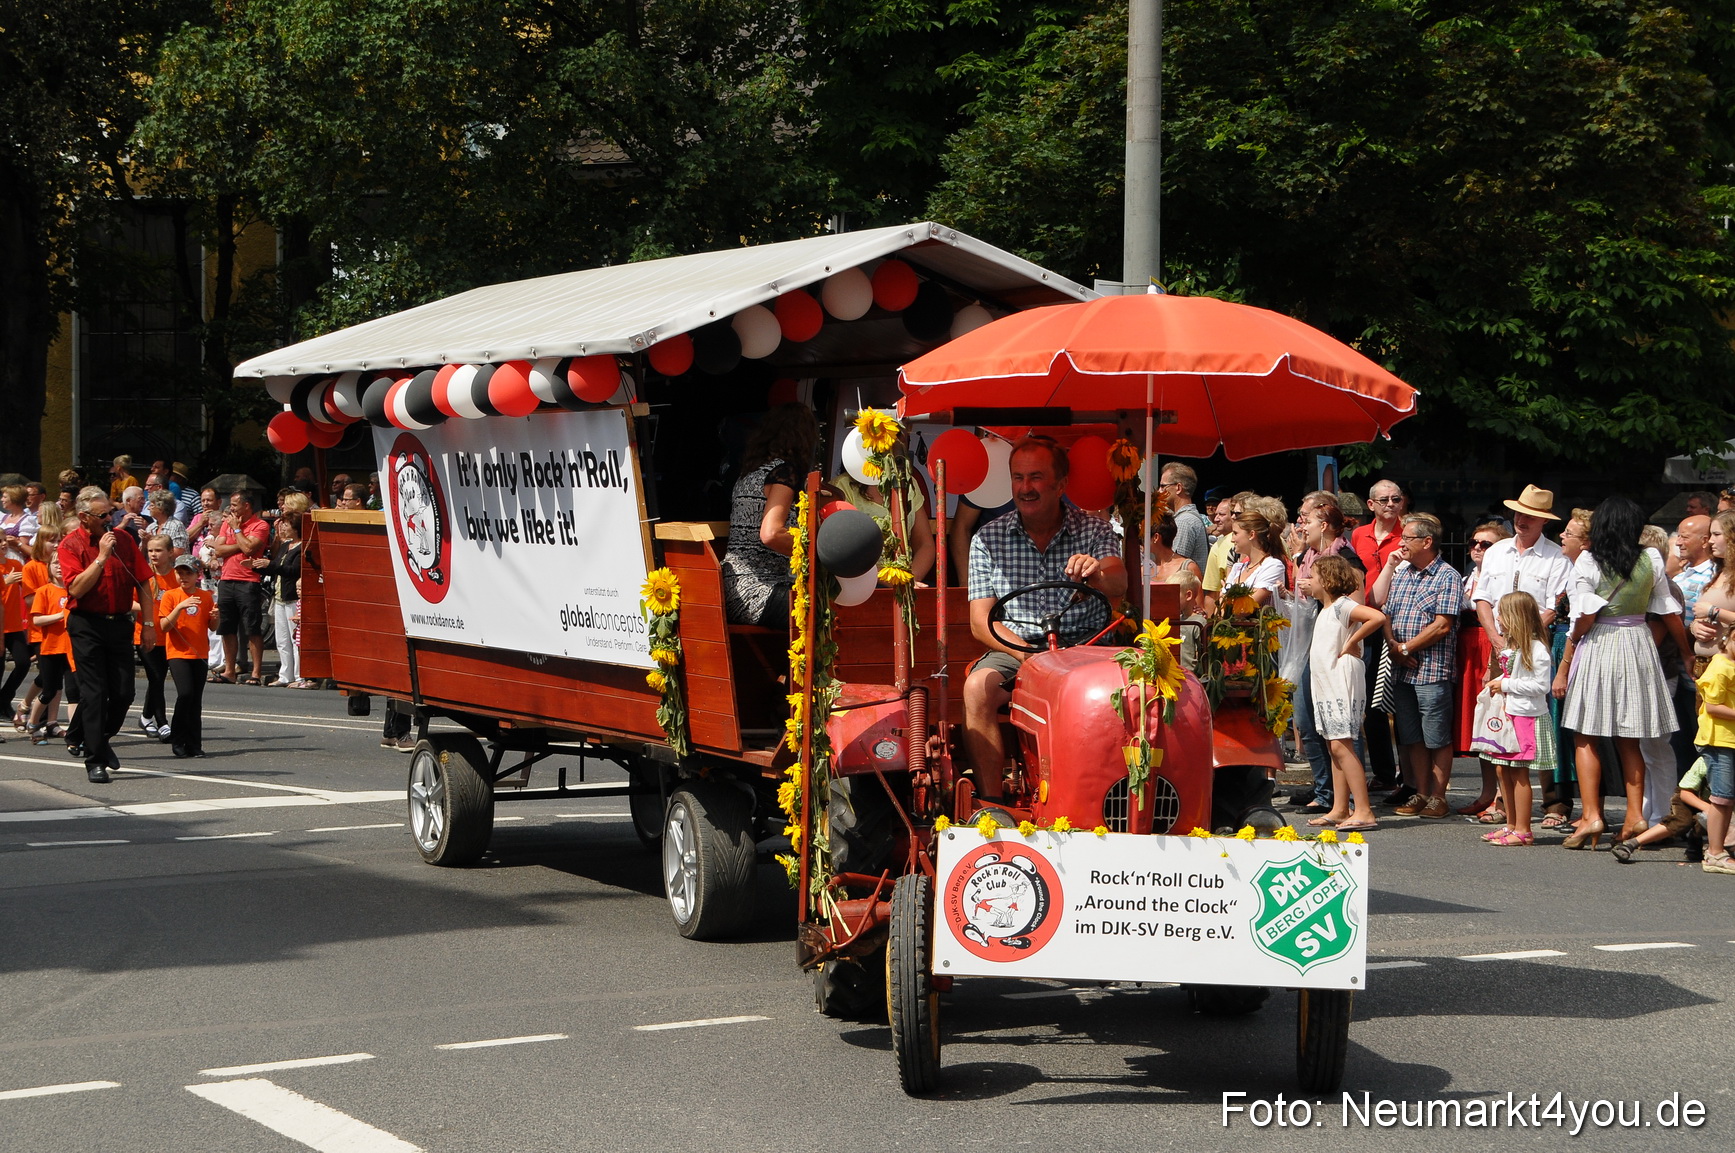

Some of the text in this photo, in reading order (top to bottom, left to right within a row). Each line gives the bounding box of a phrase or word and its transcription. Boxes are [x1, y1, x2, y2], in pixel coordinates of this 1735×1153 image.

[484, 452, 518, 495] only
[464, 506, 579, 547] but we like it!
[410, 612, 465, 630] www.rockdance.de
[560, 603, 645, 638] globalconcepts
[986, 879, 1007, 891] Club
[1188, 873, 1225, 889] Club
[1268, 865, 1312, 907] DJK
[1037, 901, 1045, 912] the
[1152, 897, 1179, 912] the
[1265, 878, 1343, 940] BERG / OPF.
[1075, 919, 1235, 942] im DJK-SV Berg e.V.
[1294, 912, 1338, 958] SV
